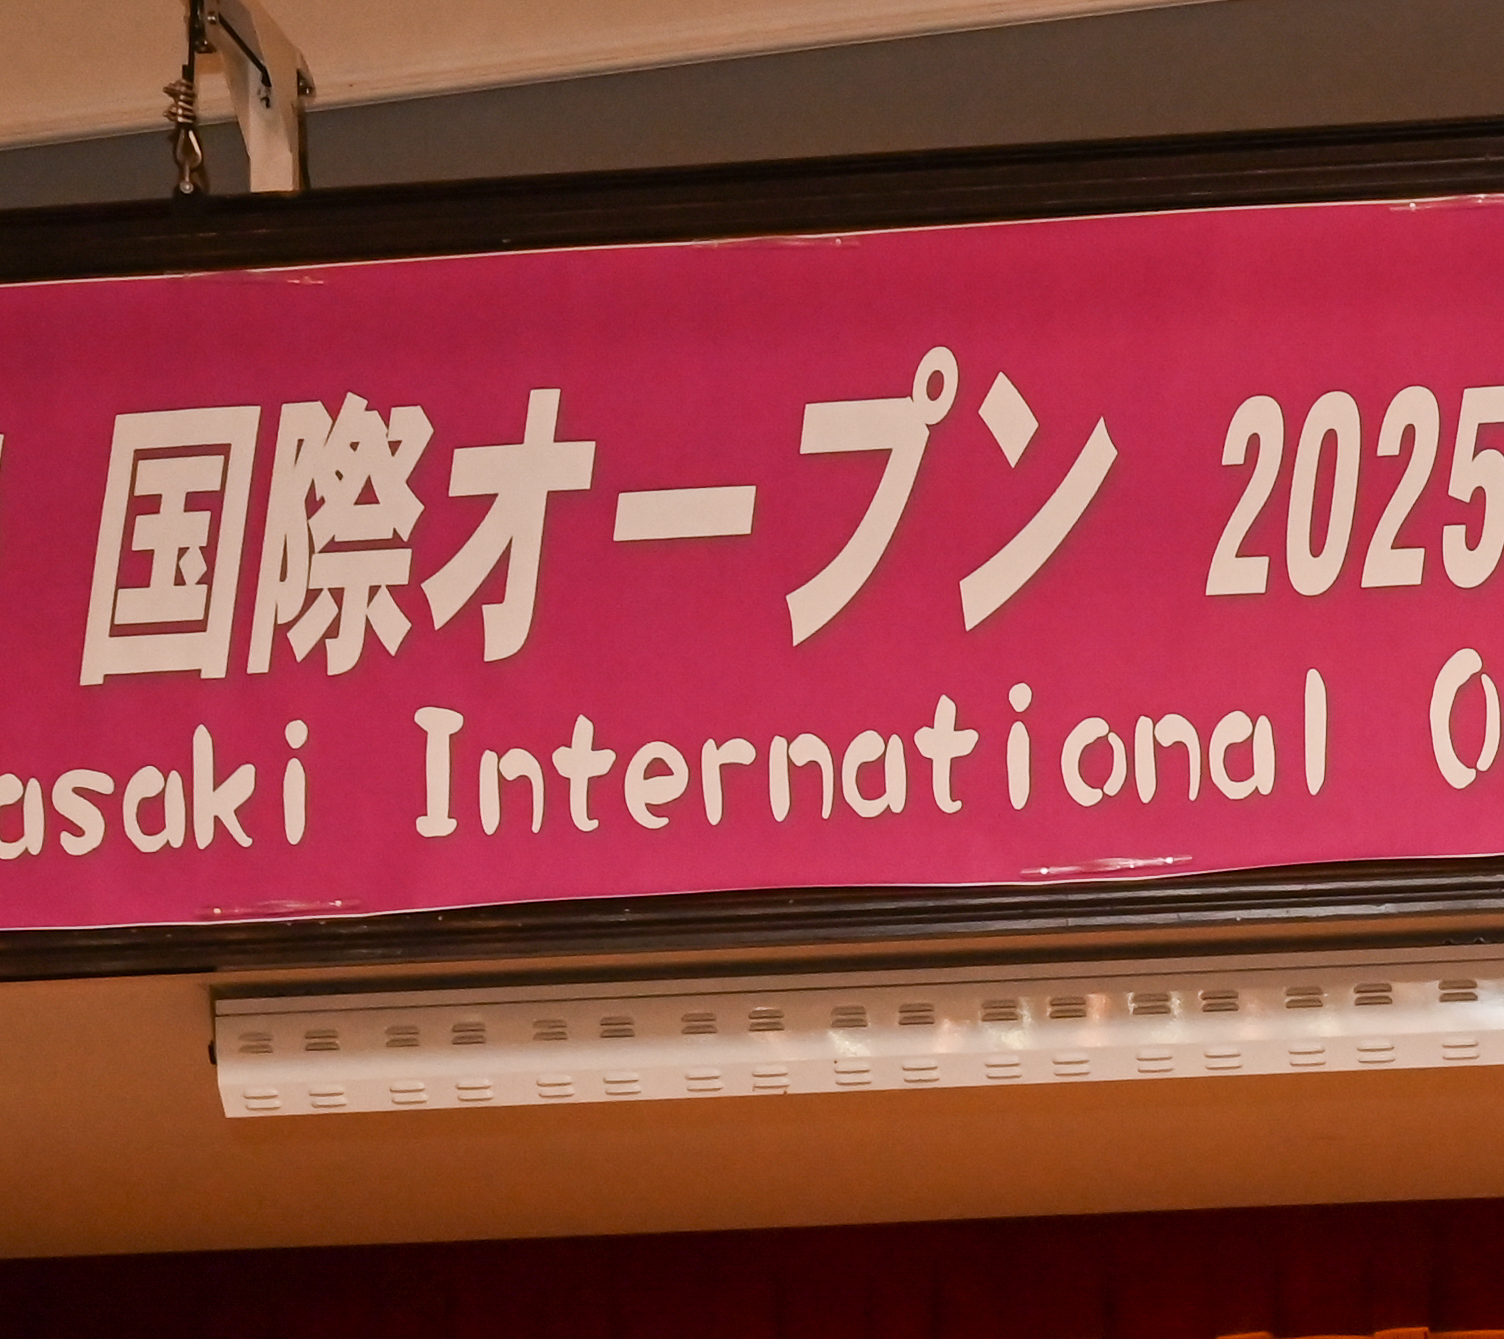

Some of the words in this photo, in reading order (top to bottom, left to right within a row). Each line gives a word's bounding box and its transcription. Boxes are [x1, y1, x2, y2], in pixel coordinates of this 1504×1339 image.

[81, 346, 1118, 686] 国際オープン
[415, 668, 1327, 838] International
